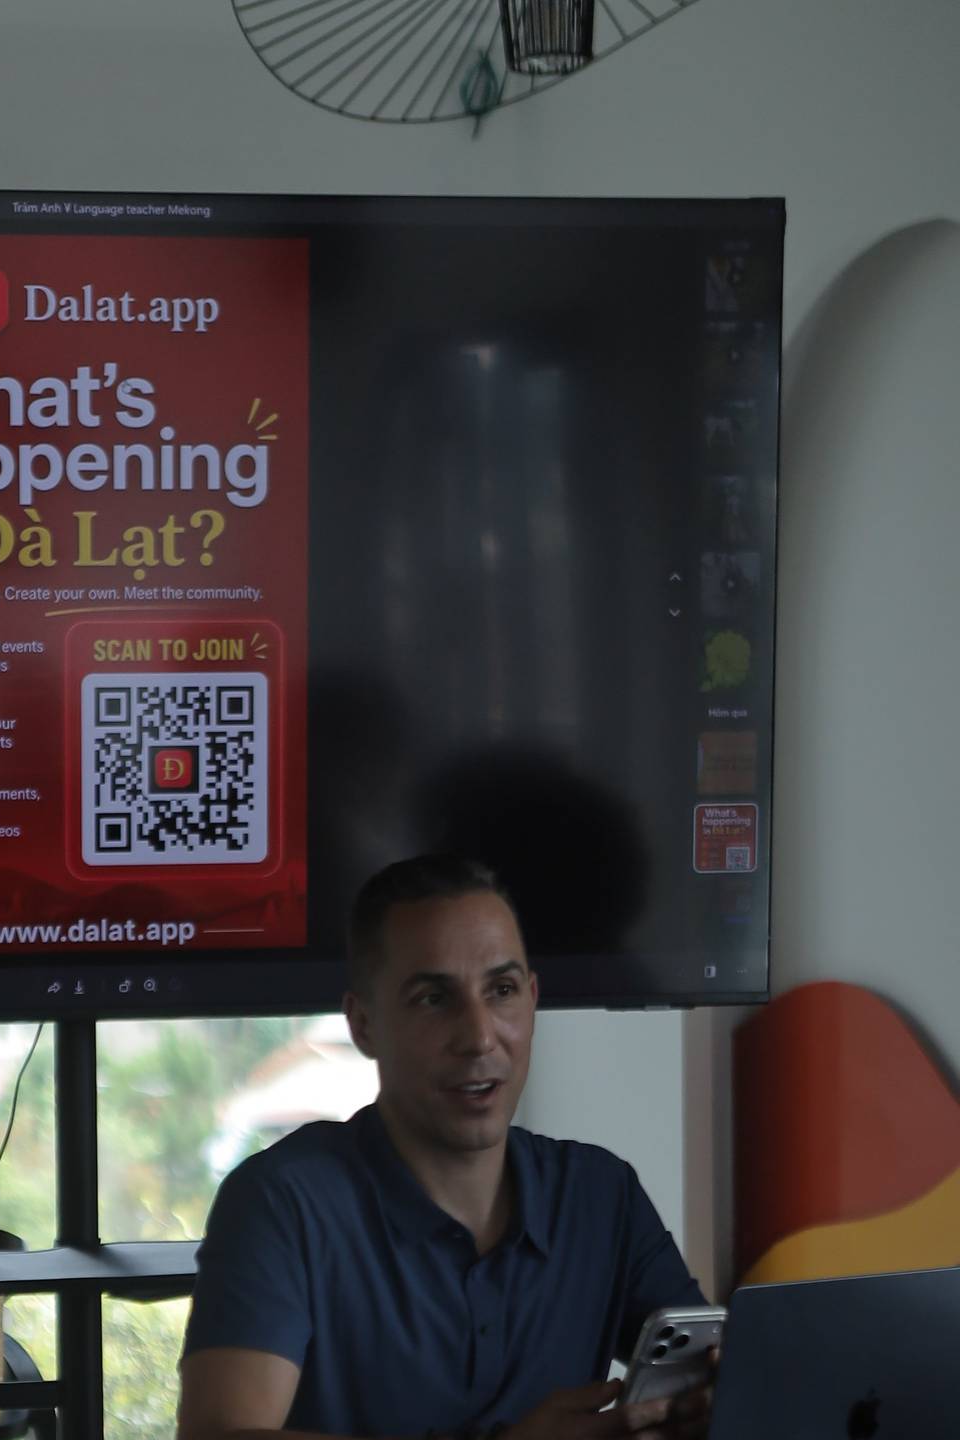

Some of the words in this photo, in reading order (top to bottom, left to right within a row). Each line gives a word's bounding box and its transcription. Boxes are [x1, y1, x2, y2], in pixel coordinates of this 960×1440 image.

[41, 203, 61, 213] Anh
[73, 203, 123, 218] Language
[126, 204, 165, 215] teacher
[167, 204, 211, 218] Mekong
[23, 284, 220, 332] Dalat.app
[73, 508, 226, 581] Lạt?
[4, 586, 50, 601] Create
[53, 589, 85, 604] your
[88, 588, 121, 601] own.
[124, 585, 159, 600] Meet
[162, 585, 184, 600] the
[187, 585, 263, 603] community.
[1, 640, 44, 654] events
[93, 639, 152, 662] SCAN
[159, 639, 187, 661] TO
[192, 638, 244, 661] JOIN
